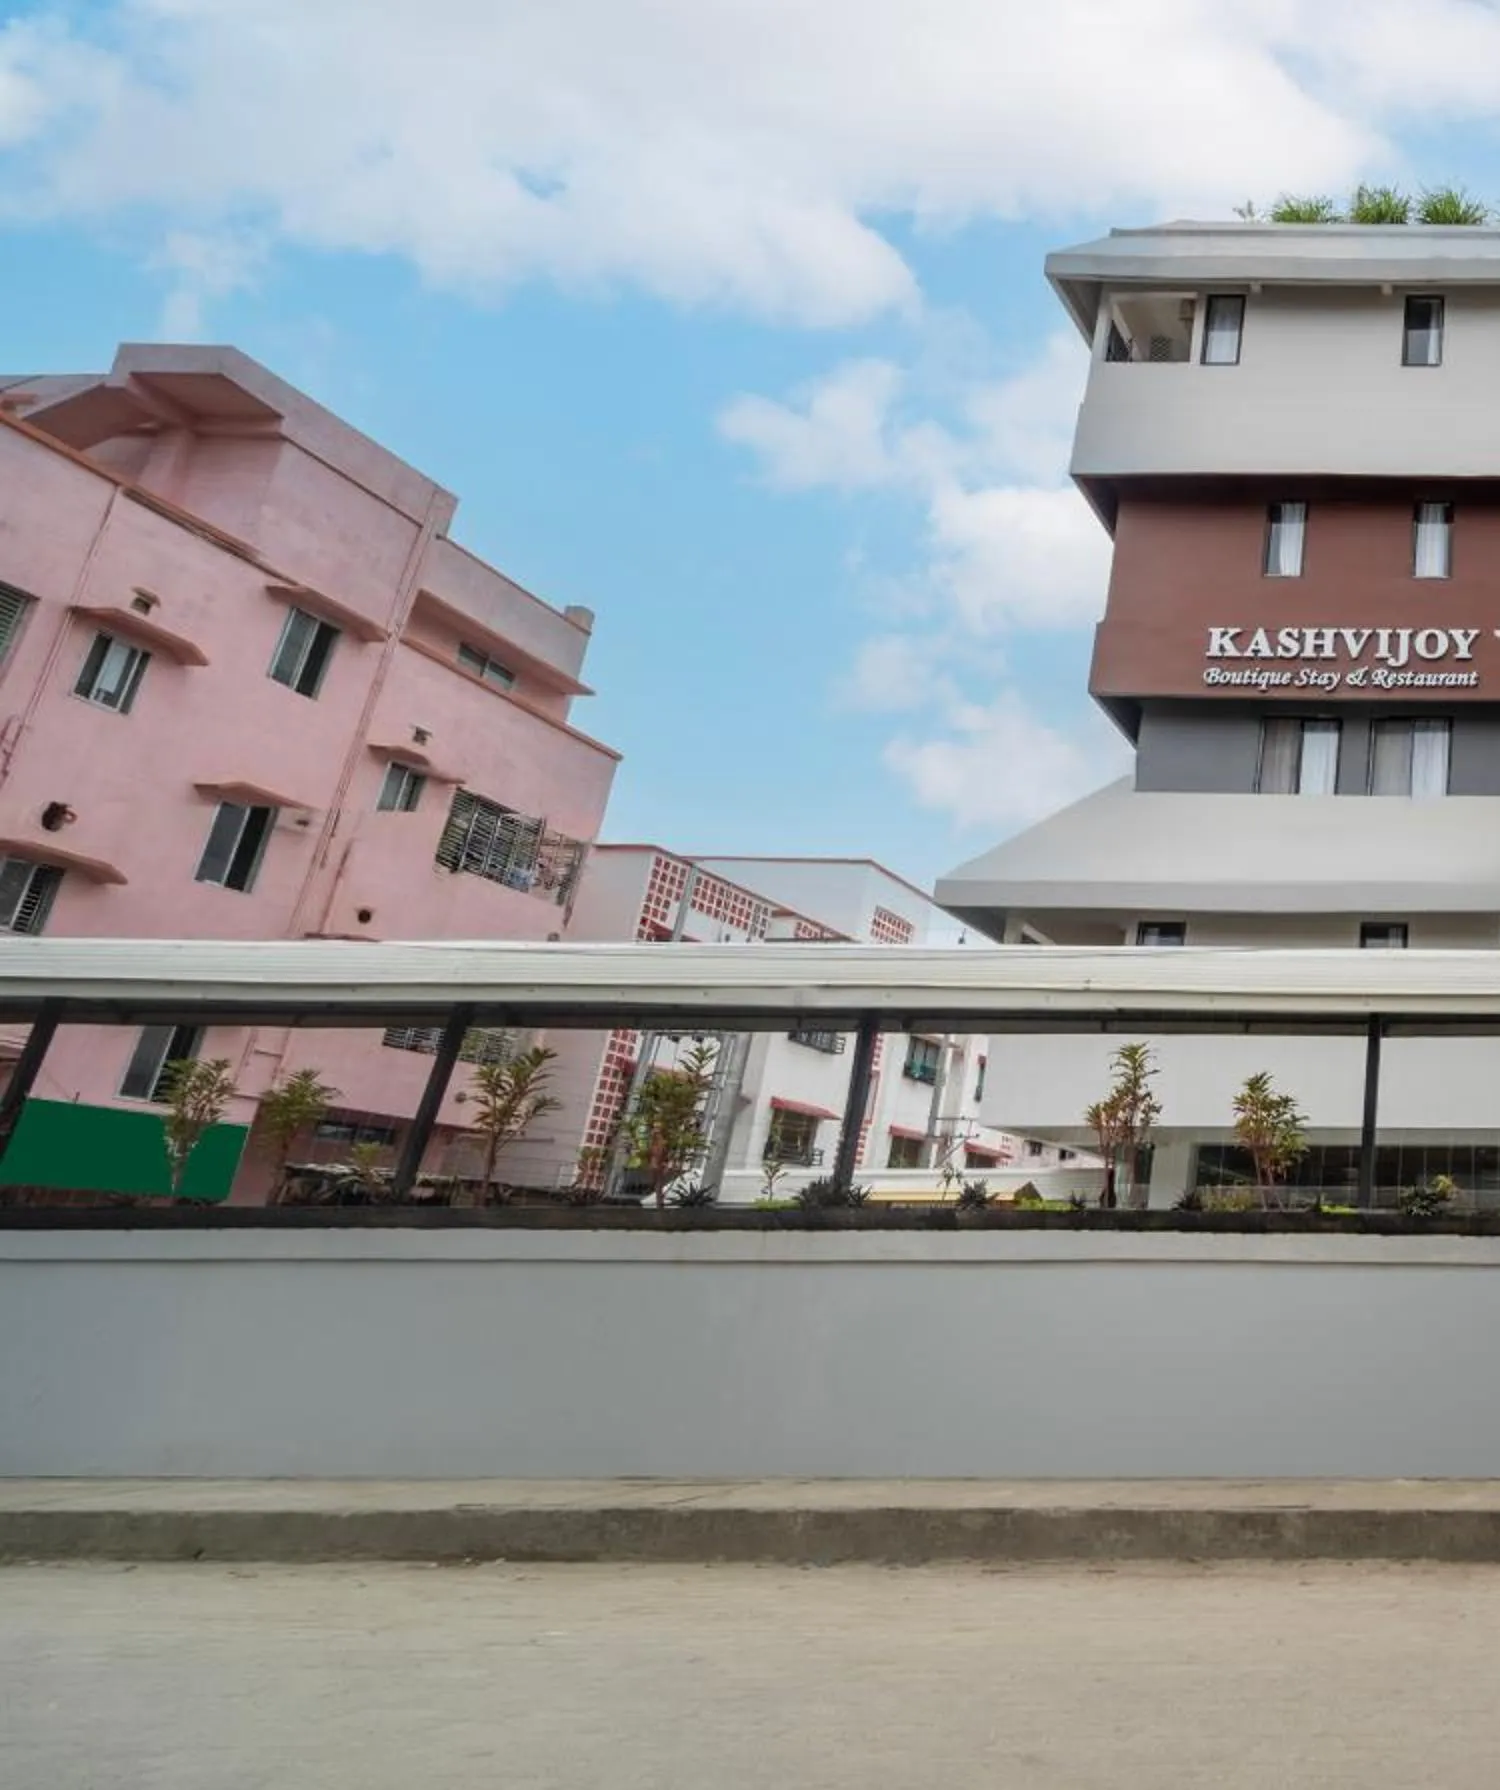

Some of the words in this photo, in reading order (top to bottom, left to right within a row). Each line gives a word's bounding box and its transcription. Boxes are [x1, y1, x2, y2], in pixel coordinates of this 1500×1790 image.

[1205, 627, 1480, 666] KASHVIJOY
[1203, 668, 1292, 690] Boutique
[1294, 668, 1341, 690] Stay
[1346, 666, 1369, 686] &
[1372, 668, 1479, 688] Restaurant
